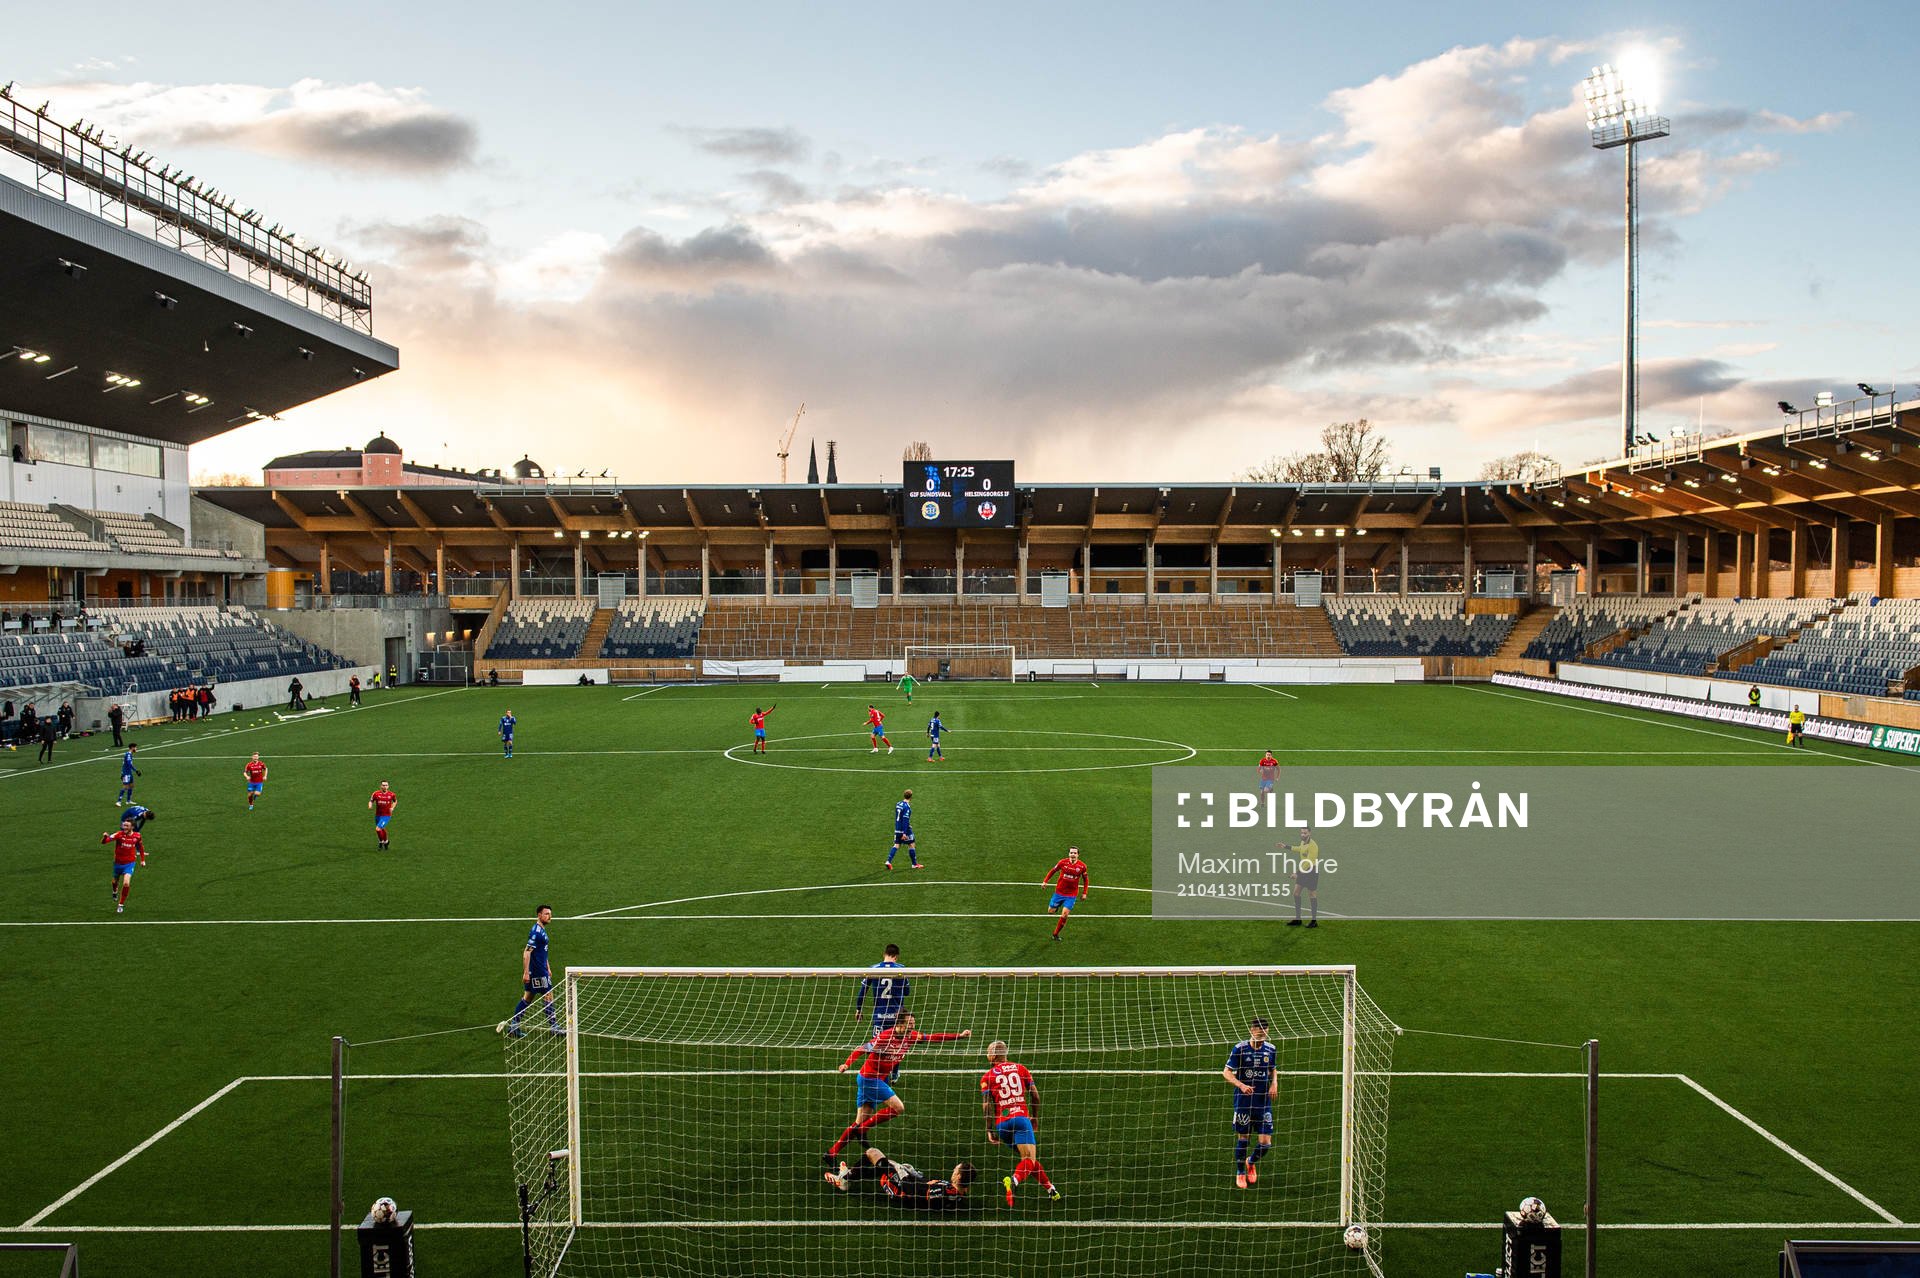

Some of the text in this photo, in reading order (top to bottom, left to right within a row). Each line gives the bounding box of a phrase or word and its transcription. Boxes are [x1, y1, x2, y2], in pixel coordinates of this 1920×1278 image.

[943, 466, 975, 478] 17:25
[926, 478, 935, 491] 0
[983, 478, 991, 491] 0
[1883, 729, 1920, 752] SUPERET
[880, 978, 893, 999] 2
[995, 1072, 1023, 1099] 39
